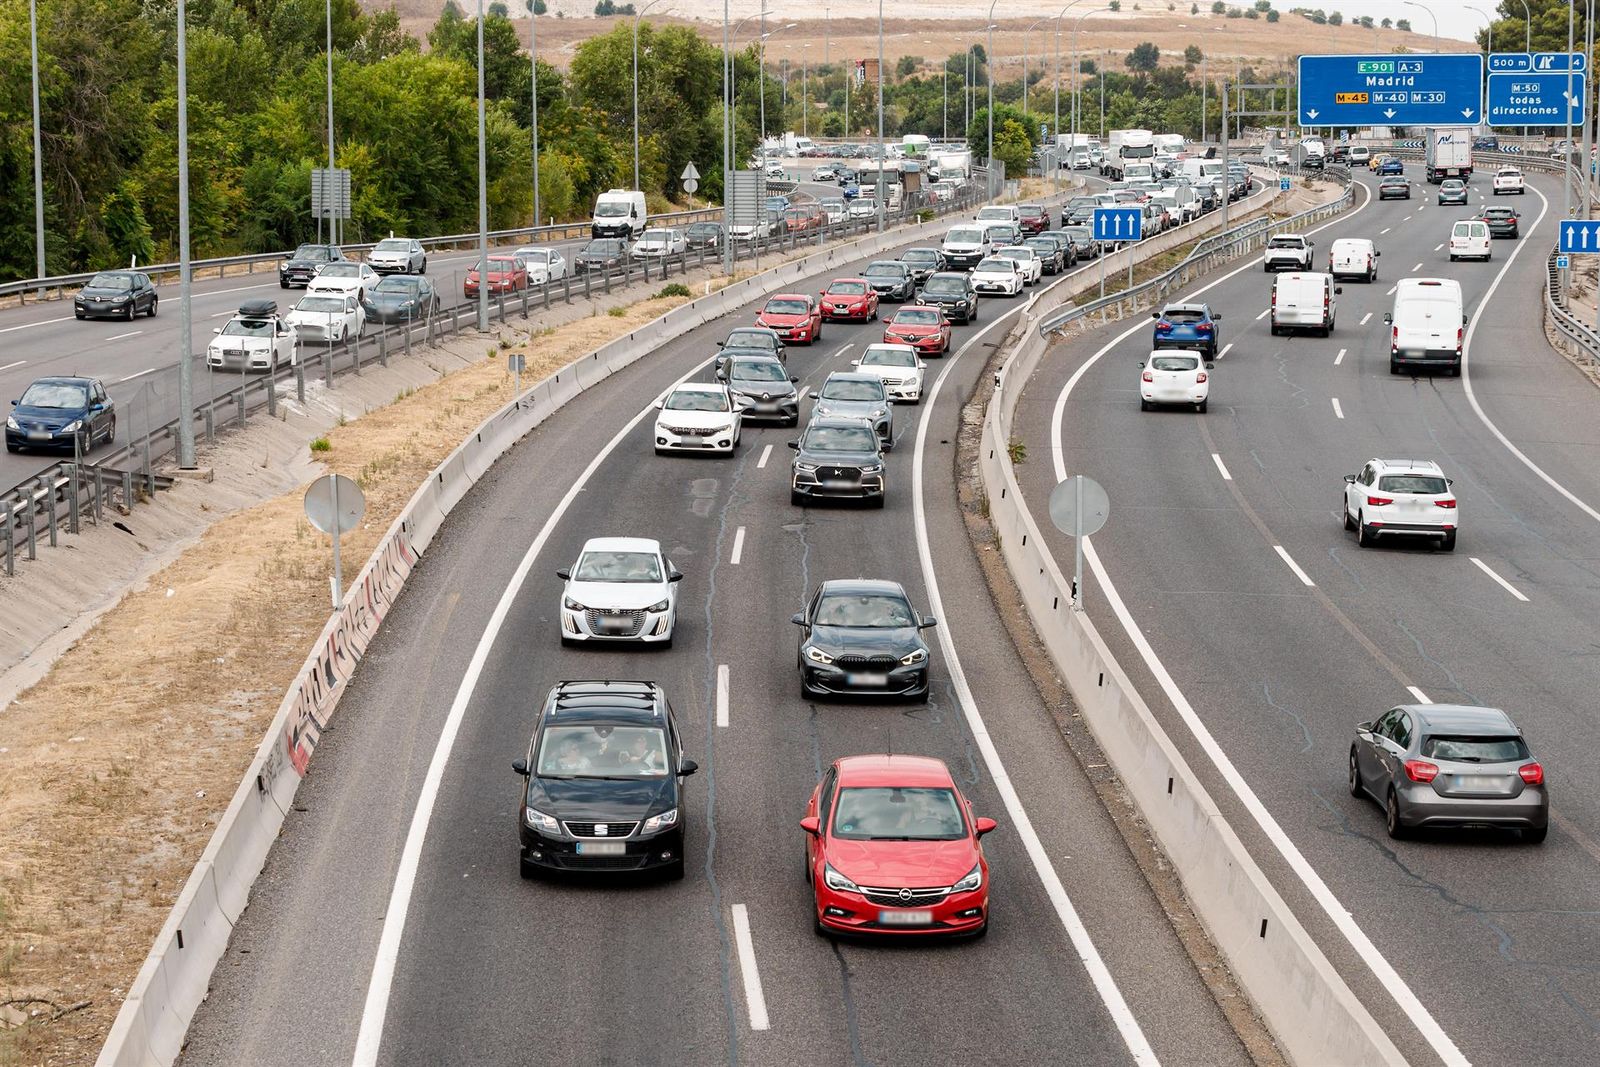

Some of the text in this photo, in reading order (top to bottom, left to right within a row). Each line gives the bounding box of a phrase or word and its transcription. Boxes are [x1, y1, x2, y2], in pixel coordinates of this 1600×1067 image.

[1493, 59, 1514, 67] 500
[1573, 58, 1580, 66] 4
[1359, 63, 1421, 72] E-901 A-3
[1366, 76, 1414, 87] Madrid
[1513, 84, 1538, 92] M-50
[1337, 93, 1443, 102] M-45 M-40 M-30
[1509, 96, 1541, 104] todas
[1492, 106, 1559, 115] direcciones
